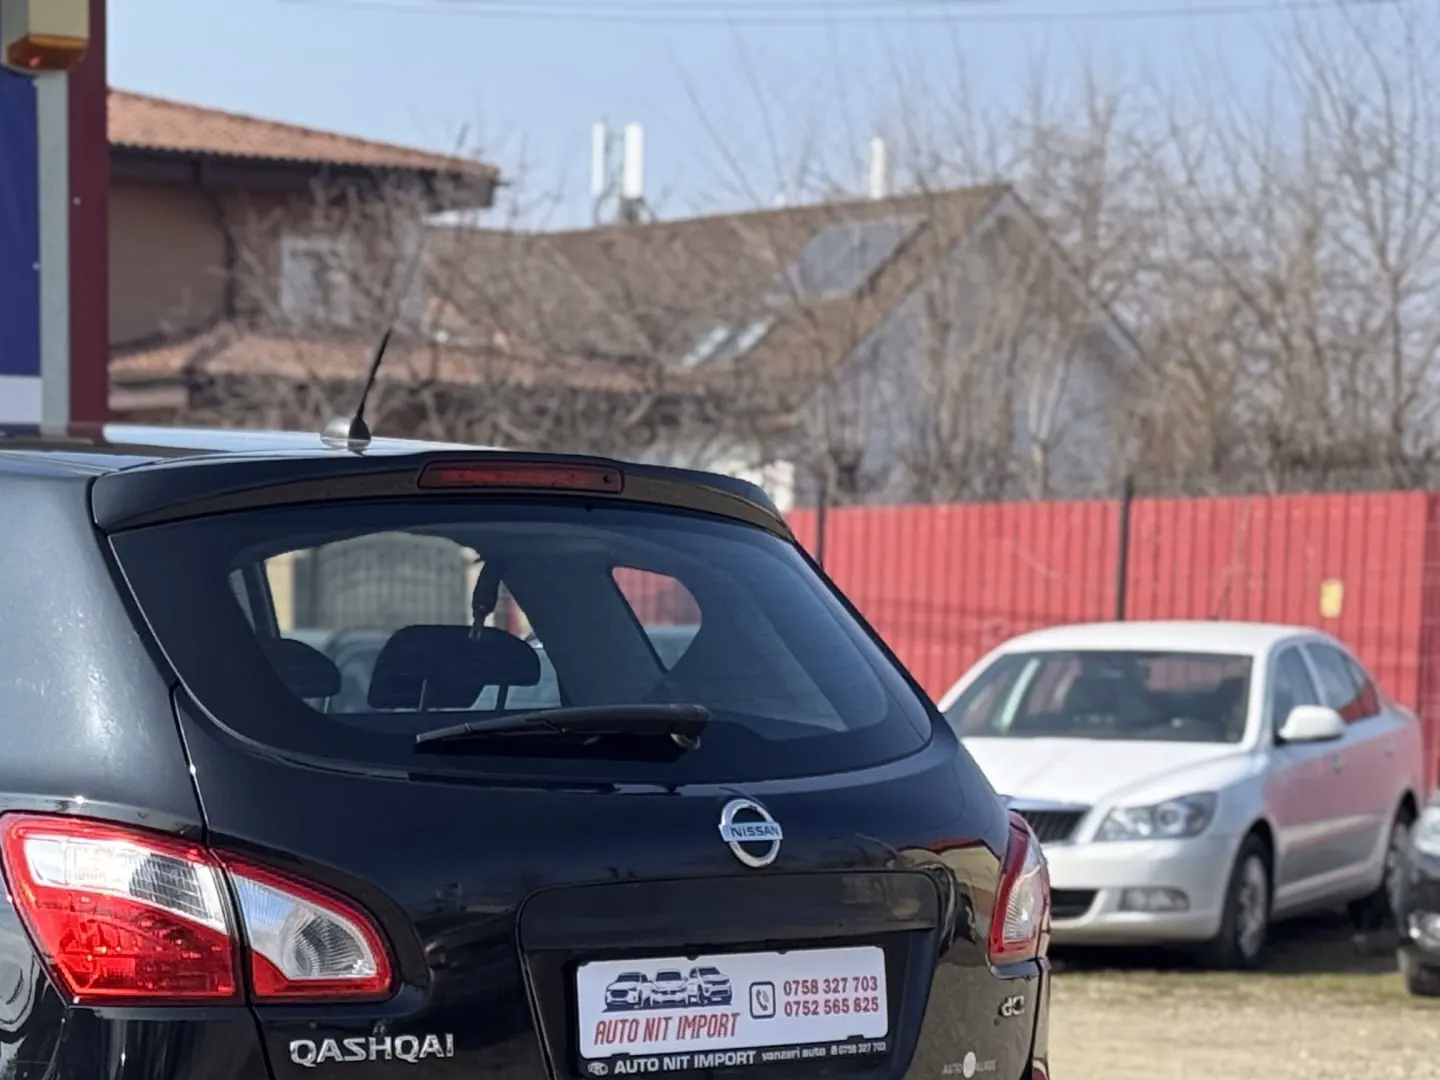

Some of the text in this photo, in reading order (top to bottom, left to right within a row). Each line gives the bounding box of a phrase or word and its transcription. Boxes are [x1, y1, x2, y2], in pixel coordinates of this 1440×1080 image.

[730, 825, 781, 838] NISSAN
[783, 975, 878, 997] 0758 327 703
[784, 996, 879, 1018] 0752 565 825
[594, 1012, 741, 1046] AUTO NIT IMPORT
[289, 1033, 454, 1068] QASHQAI
[613, 1058, 659, 1075] AUTO
[663, 1055, 690, 1071] NIT
[694, 1050, 757, 1069] IMPORT
[802, 1047, 826, 1058] auto
